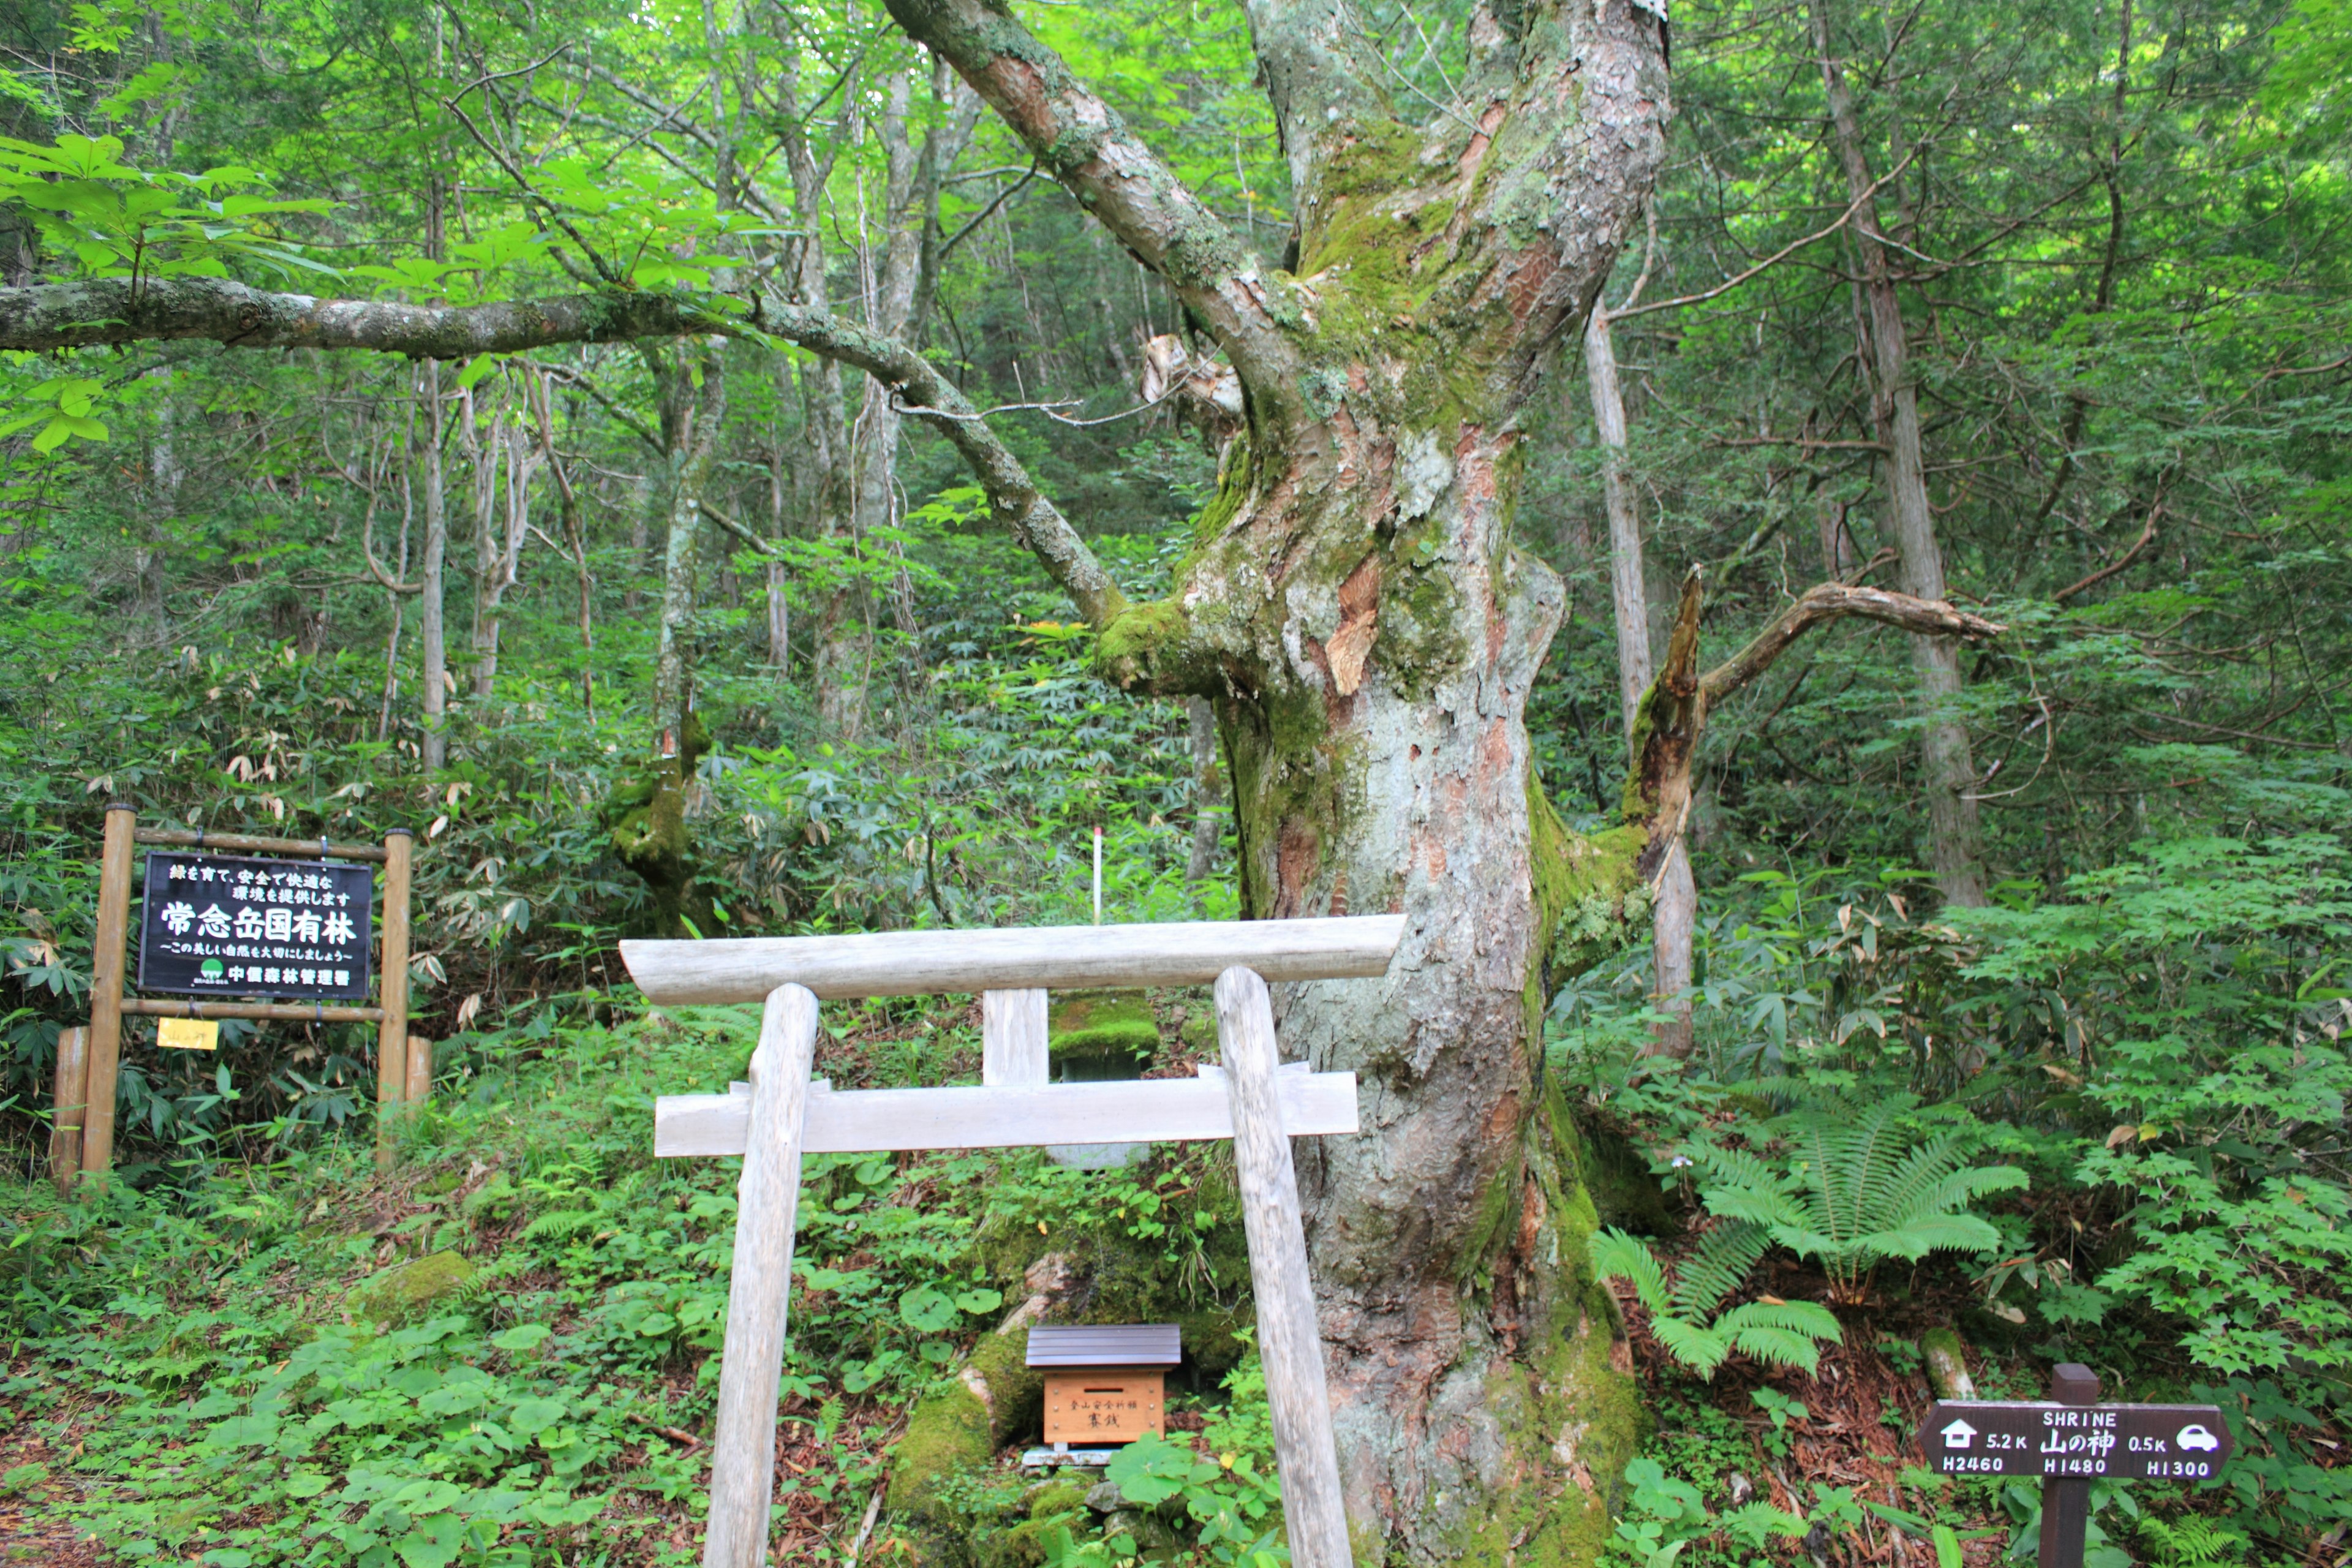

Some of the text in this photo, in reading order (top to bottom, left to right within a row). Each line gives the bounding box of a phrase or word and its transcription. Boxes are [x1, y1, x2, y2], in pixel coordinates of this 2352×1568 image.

[232, 886, 350, 907] 環境を提供します
[160, 900, 357, 945] 常念岳国有林
[227, 965, 350, 987] 中信森林管理署
[2043, 1411, 2117, 1427] SHRINE
[2040, 1428, 2116, 1458] 山の神
[1943, 1456, 2003, 1471] H2460
[2044, 1458, 2106, 1473] H1480
[2147, 1461, 2209, 1476] H1300
